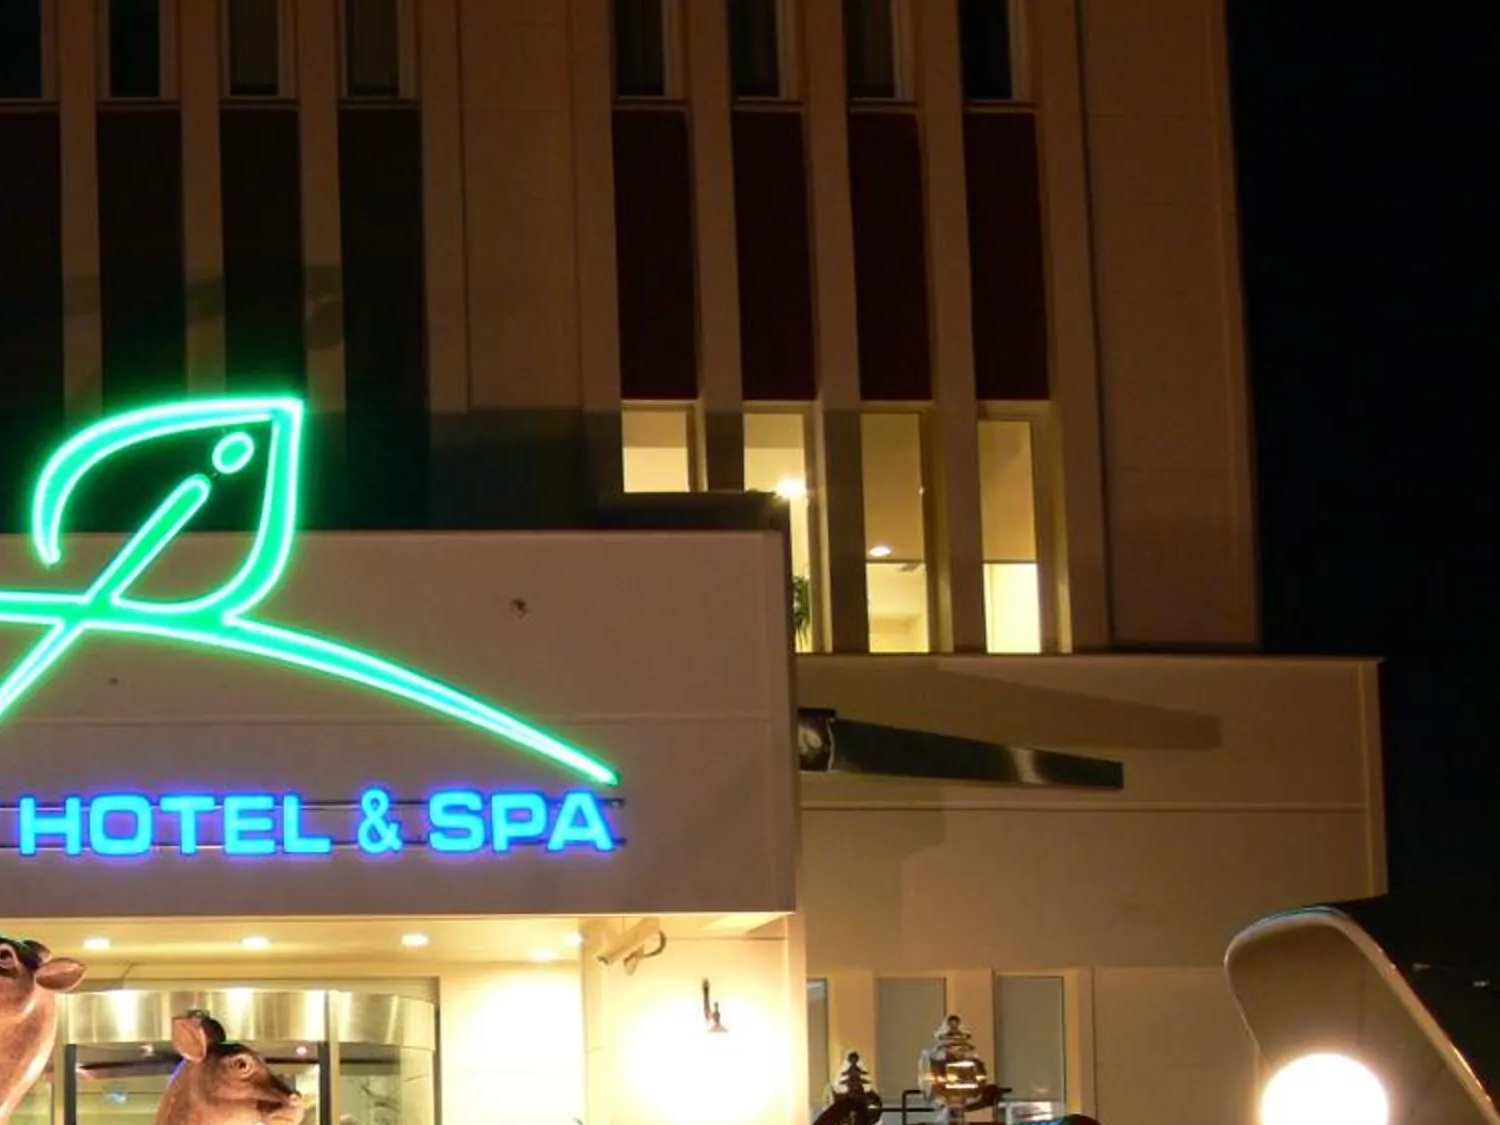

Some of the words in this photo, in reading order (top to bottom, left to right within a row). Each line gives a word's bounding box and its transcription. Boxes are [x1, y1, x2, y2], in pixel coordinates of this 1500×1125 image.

[18, 793, 332, 857] HOTEL
[357, 787, 402, 854] &
[427, 789, 615, 853] SPA
